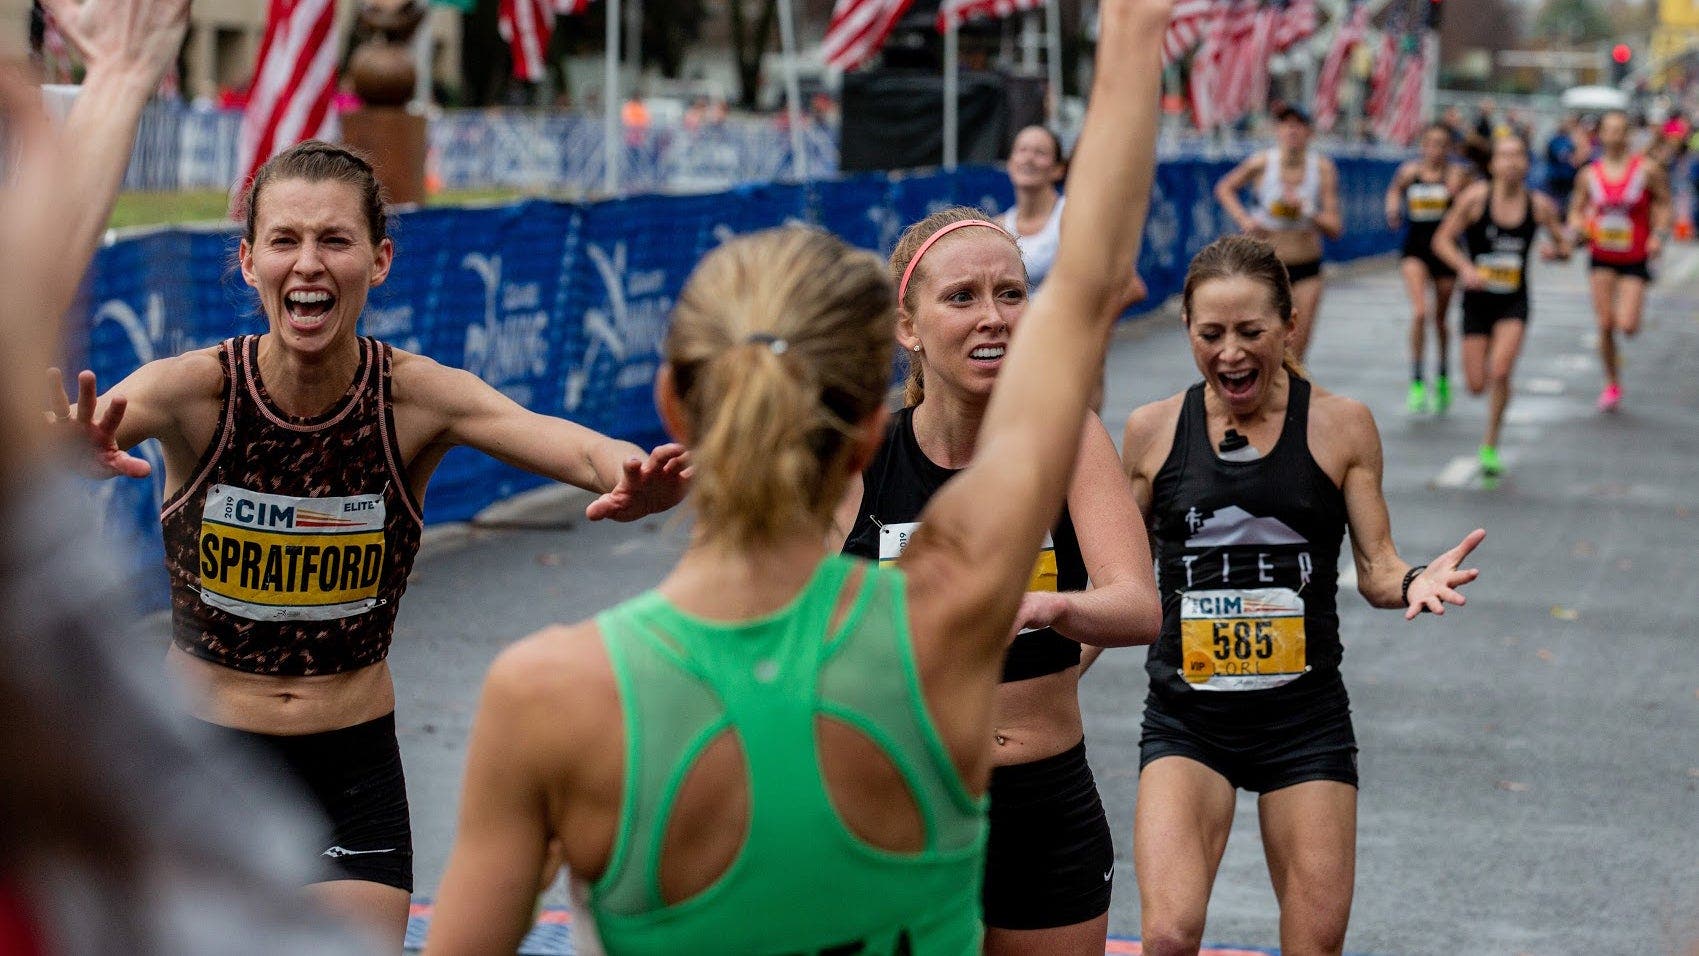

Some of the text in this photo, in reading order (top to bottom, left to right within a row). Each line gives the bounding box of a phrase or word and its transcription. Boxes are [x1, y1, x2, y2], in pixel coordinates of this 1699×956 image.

[224, 496, 234, 519] 2019
[235, 499, 295, 528] CIM
[344, 500, 375, 512] ELITE
[201, 532, 383, 593] SPRATFORD
[1181, 552, 1313, 588] TIER
[1199, 597, 1242, 615] CIM
[1212, 621, 1273, 660] 585
[1190, 660, 1206, 672] VIP
